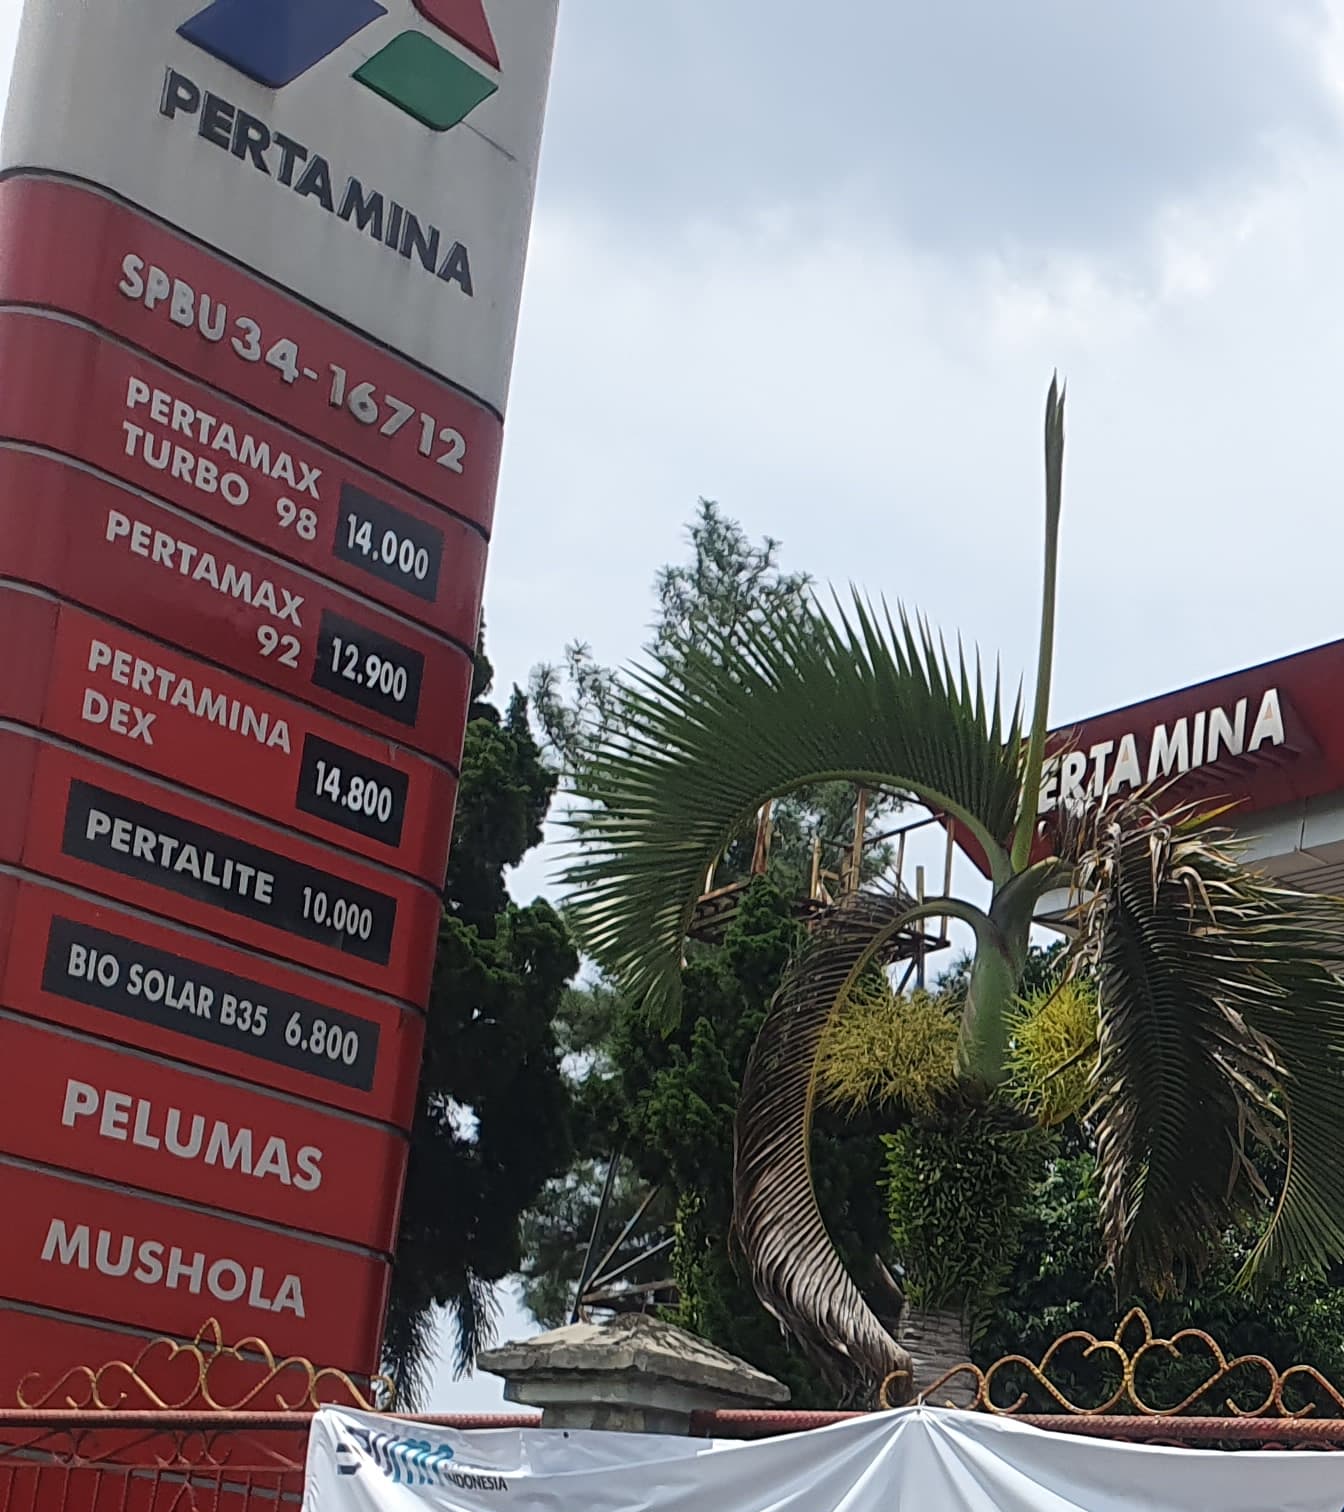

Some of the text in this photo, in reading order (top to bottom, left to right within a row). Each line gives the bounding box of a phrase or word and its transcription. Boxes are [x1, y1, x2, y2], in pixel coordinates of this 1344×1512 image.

[158, 66, 474, 297] PERTAMINA
[118, 253, 468, 474] SPBU 34-16712
[122, 421, 318, 542] TURBO 98
[126, 376, 321, 500] PERTAMAX
[105, 509, 304, 626] PERTAMAX
[346, 511, 430, 581] 14.000
[87, 640, 292, 755] PERTAMINA
[256, 624, 301, 669] 92
[330, 637, 408, 702] 12.900
[82, 688, 156, 745] DEX
[1017, 688, 1284, 815] ERTAMINA
[314, 760, 392, 824] 14.800
[85, 808, 373, 941] PERTALITE 10.000
[67, 943, 359, 1066] BIO SOLAR B35 6.800
[61, 1077, 324, 1192] PELUMAS
[41, 1218, 306, 1318] MUSHOLA
